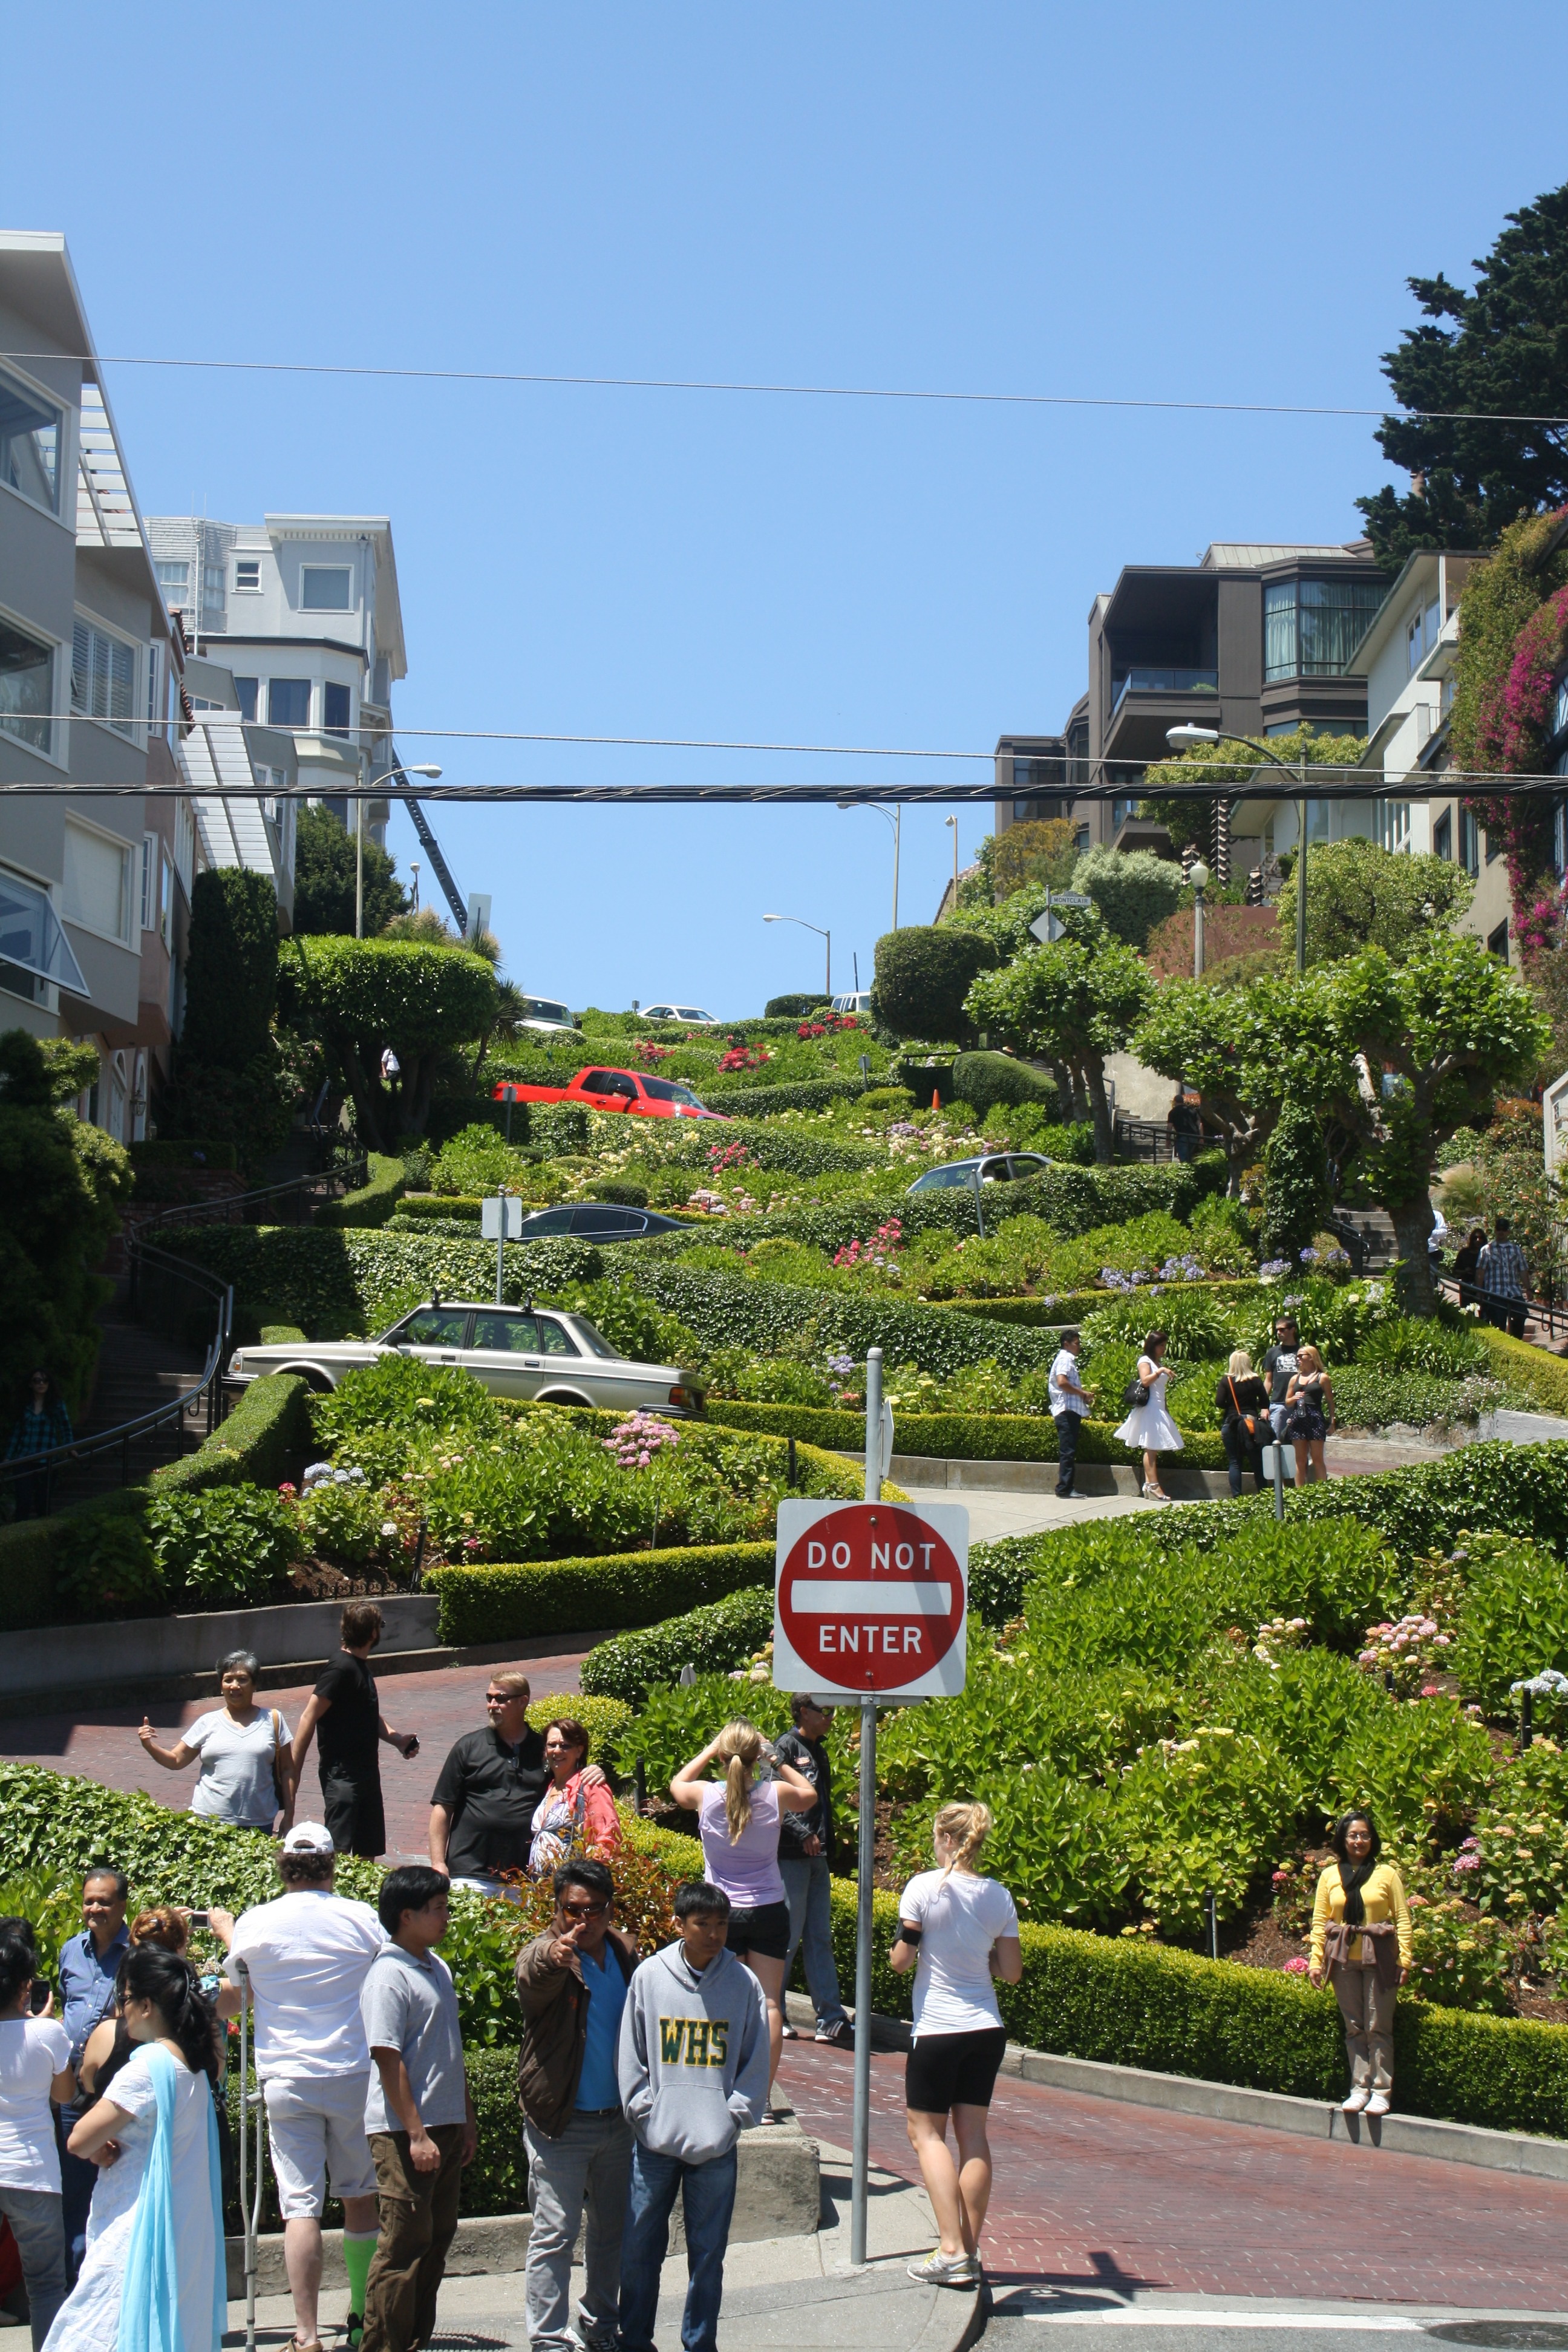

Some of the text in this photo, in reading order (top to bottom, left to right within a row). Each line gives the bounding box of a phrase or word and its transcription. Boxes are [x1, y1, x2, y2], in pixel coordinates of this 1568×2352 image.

[808, 1542, 935, 1569] DO NOT
[819, 1625, 922, 1653] ENTER
[659, 2016, 729, 2068] WHS
